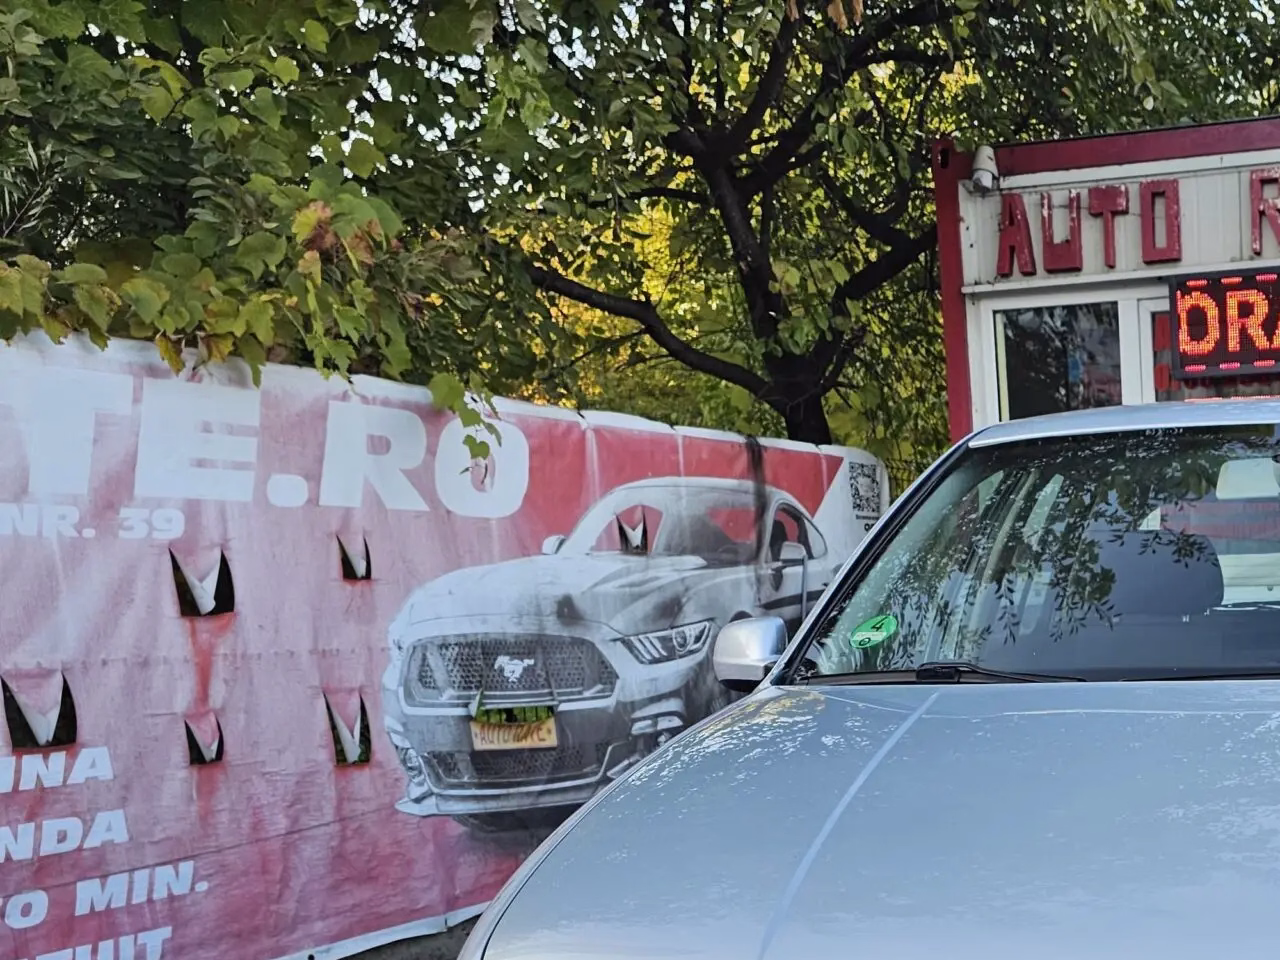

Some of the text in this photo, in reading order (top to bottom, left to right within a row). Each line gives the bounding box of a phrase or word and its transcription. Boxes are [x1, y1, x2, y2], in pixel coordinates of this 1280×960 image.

[998, 178, 1183, 277] AUTO
[117, 507, 186, 540] 39
[75, 860, 208, 916] MIN.
